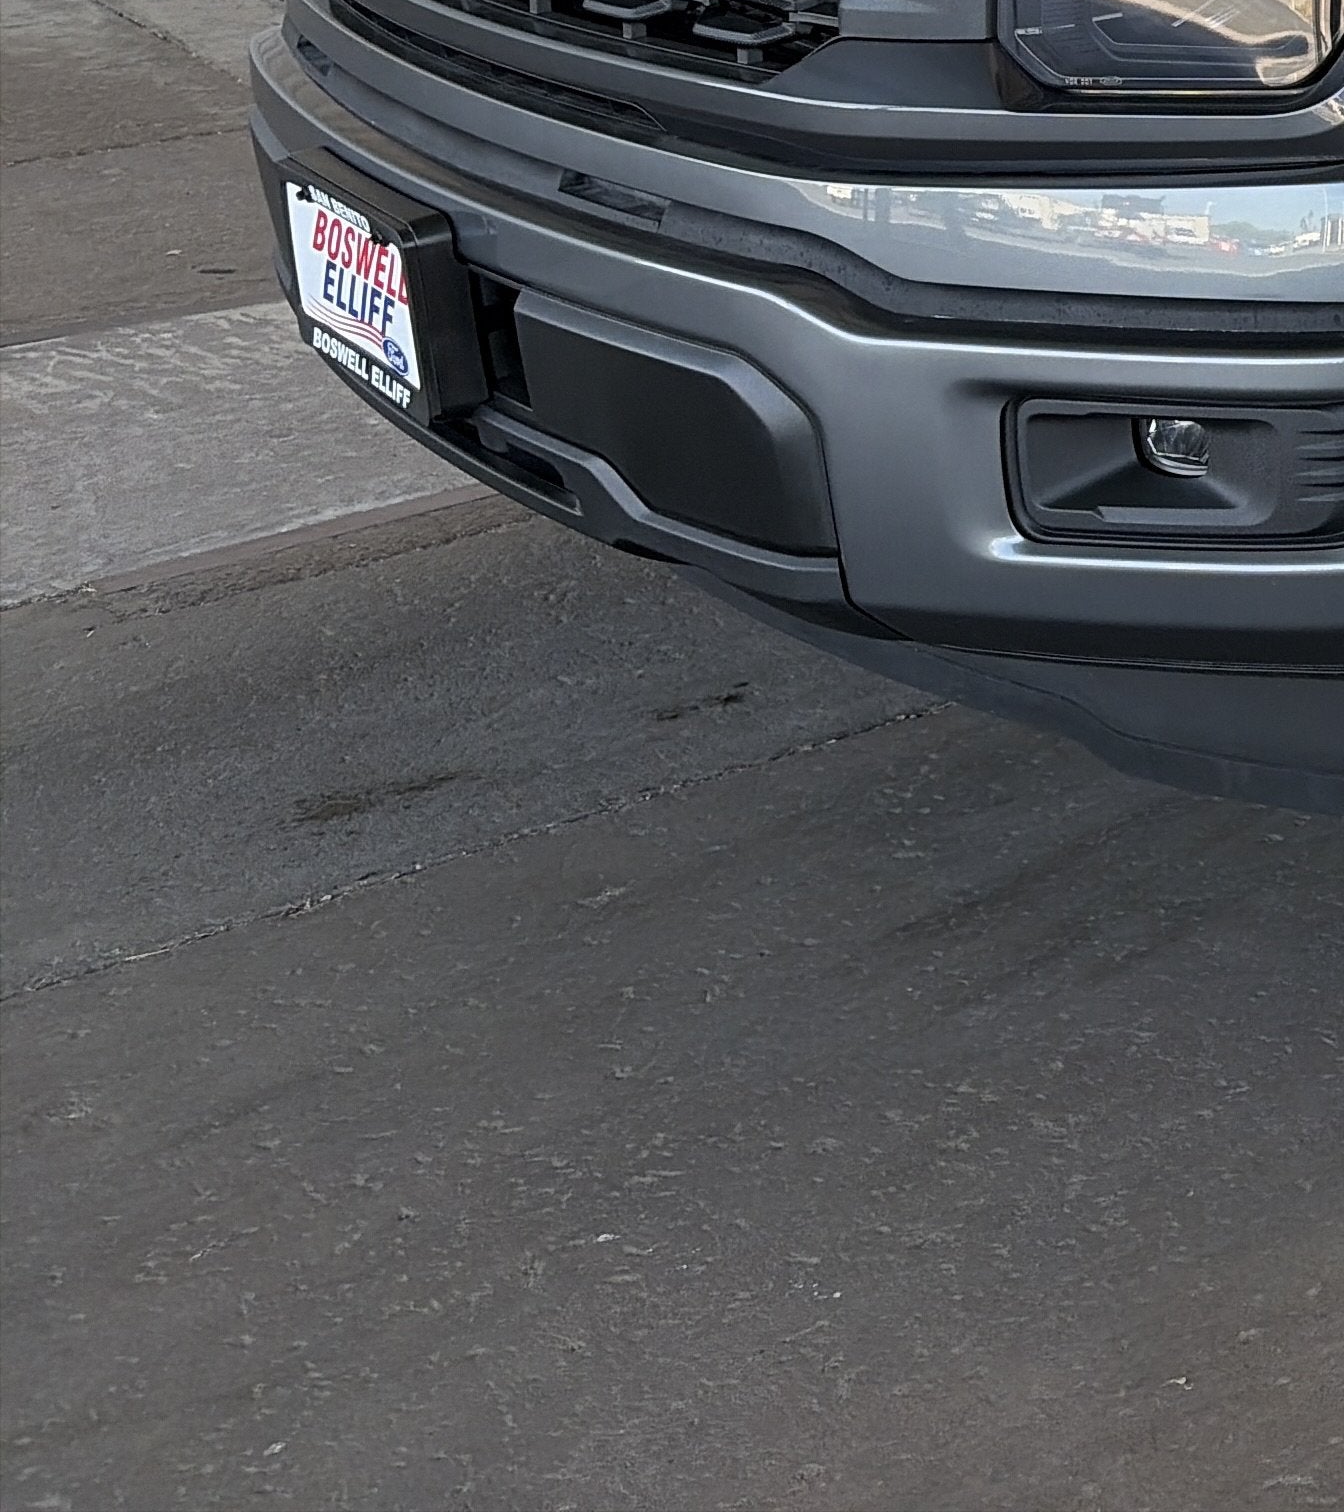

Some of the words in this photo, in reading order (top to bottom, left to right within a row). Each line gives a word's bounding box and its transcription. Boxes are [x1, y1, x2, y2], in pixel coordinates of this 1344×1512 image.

[332, 197, 370, 233] BENITO
[312, 209, 409, 306] BOSWELL
[322, 259, 396, 336] ELLIFF
[312, 326, 369, 382] BOSWELL
[370, 367, 411, 409] ELLIFF
